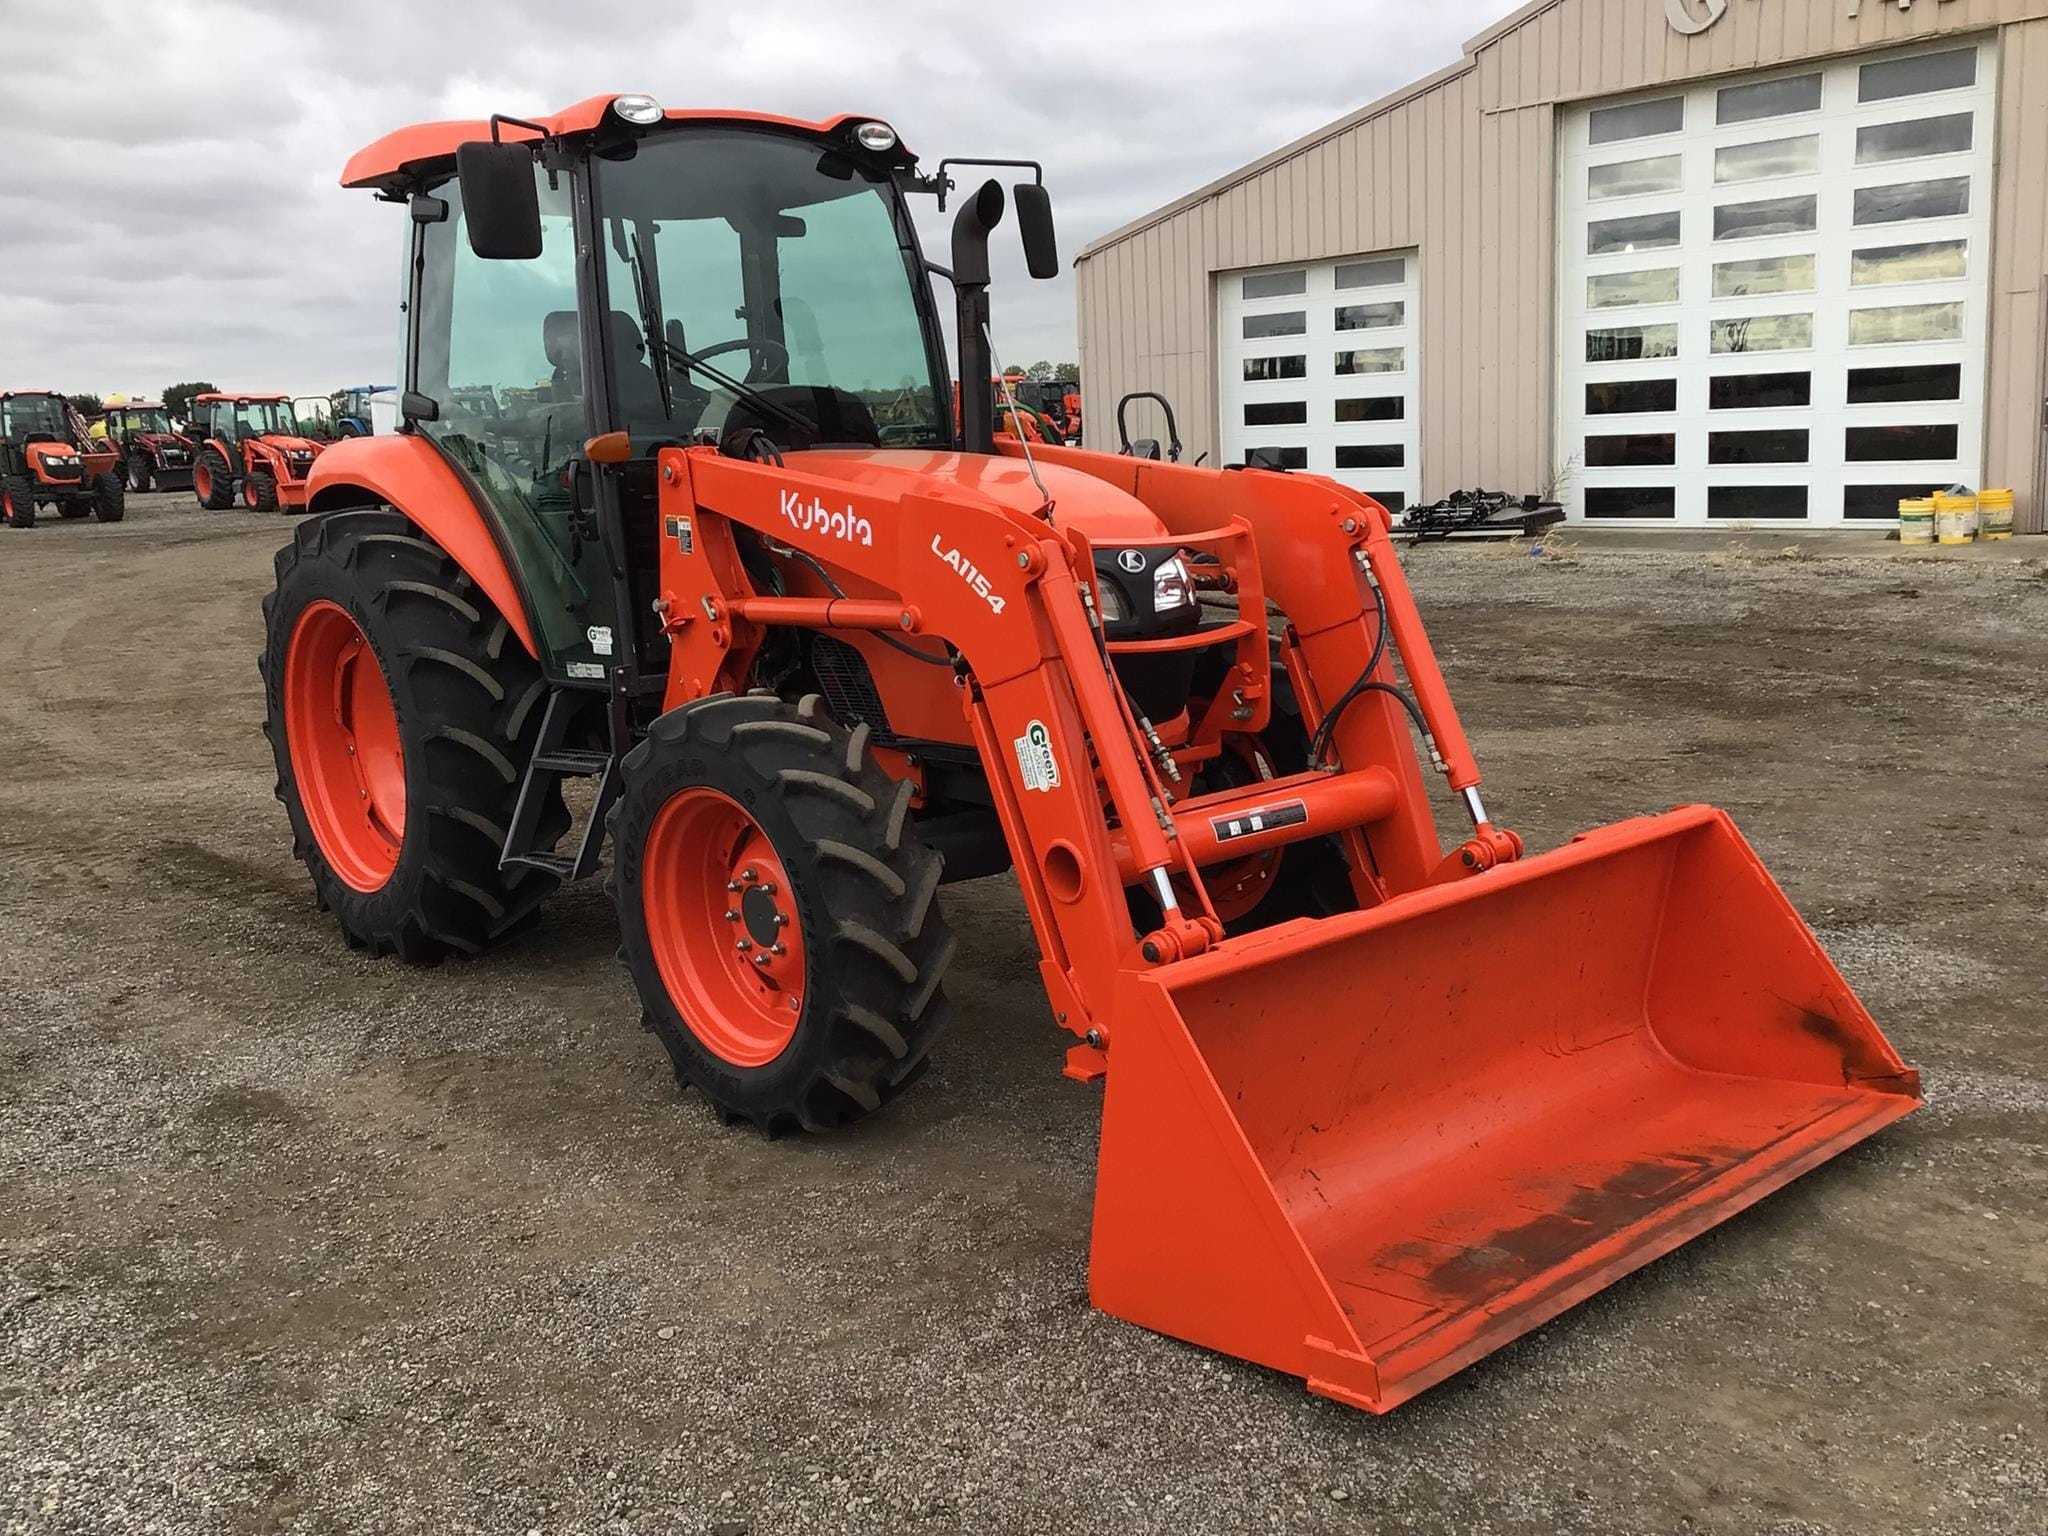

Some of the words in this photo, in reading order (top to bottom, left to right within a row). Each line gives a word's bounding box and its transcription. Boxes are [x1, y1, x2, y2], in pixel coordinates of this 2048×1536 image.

[781, 489, 872, 546] Kubota
[931, 534, 1006, 615] LA1154
[1030, 725, 1055, 780] Green
